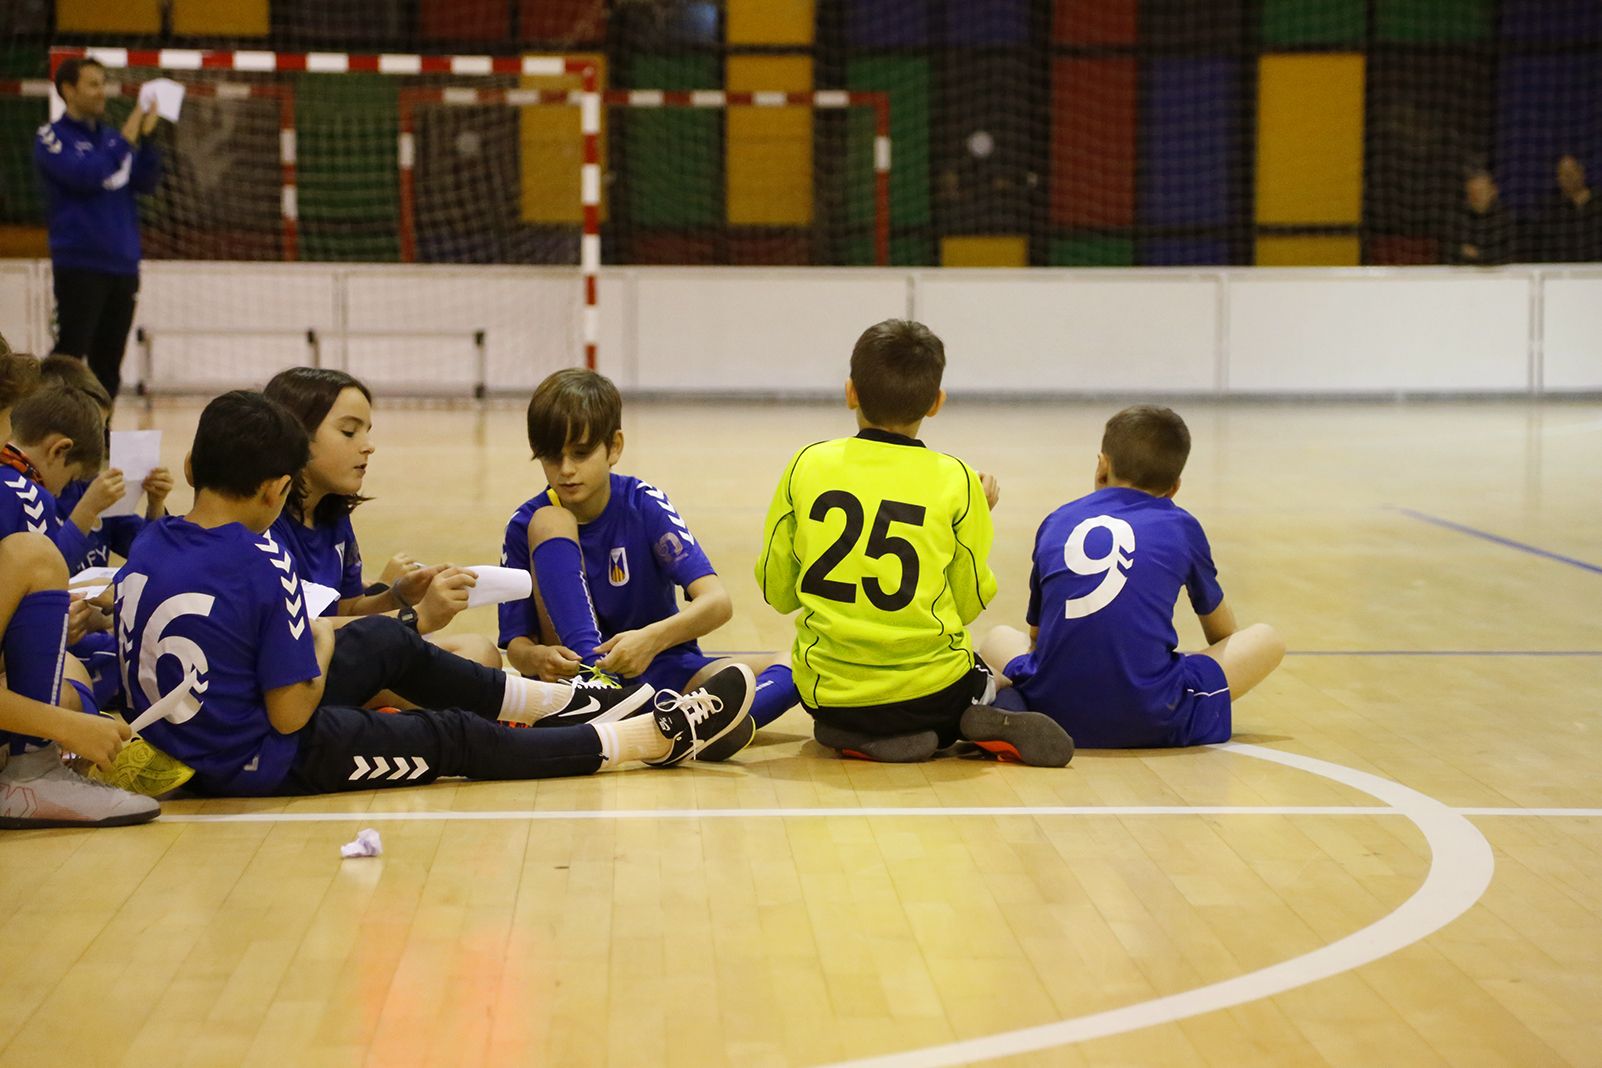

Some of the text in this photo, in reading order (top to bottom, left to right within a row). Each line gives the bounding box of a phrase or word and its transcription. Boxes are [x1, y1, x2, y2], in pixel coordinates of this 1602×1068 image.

[800, 490, 927, 612] 25
[1064, 515, 1136, 620] 9
[115, 572, 216, 724] 16
